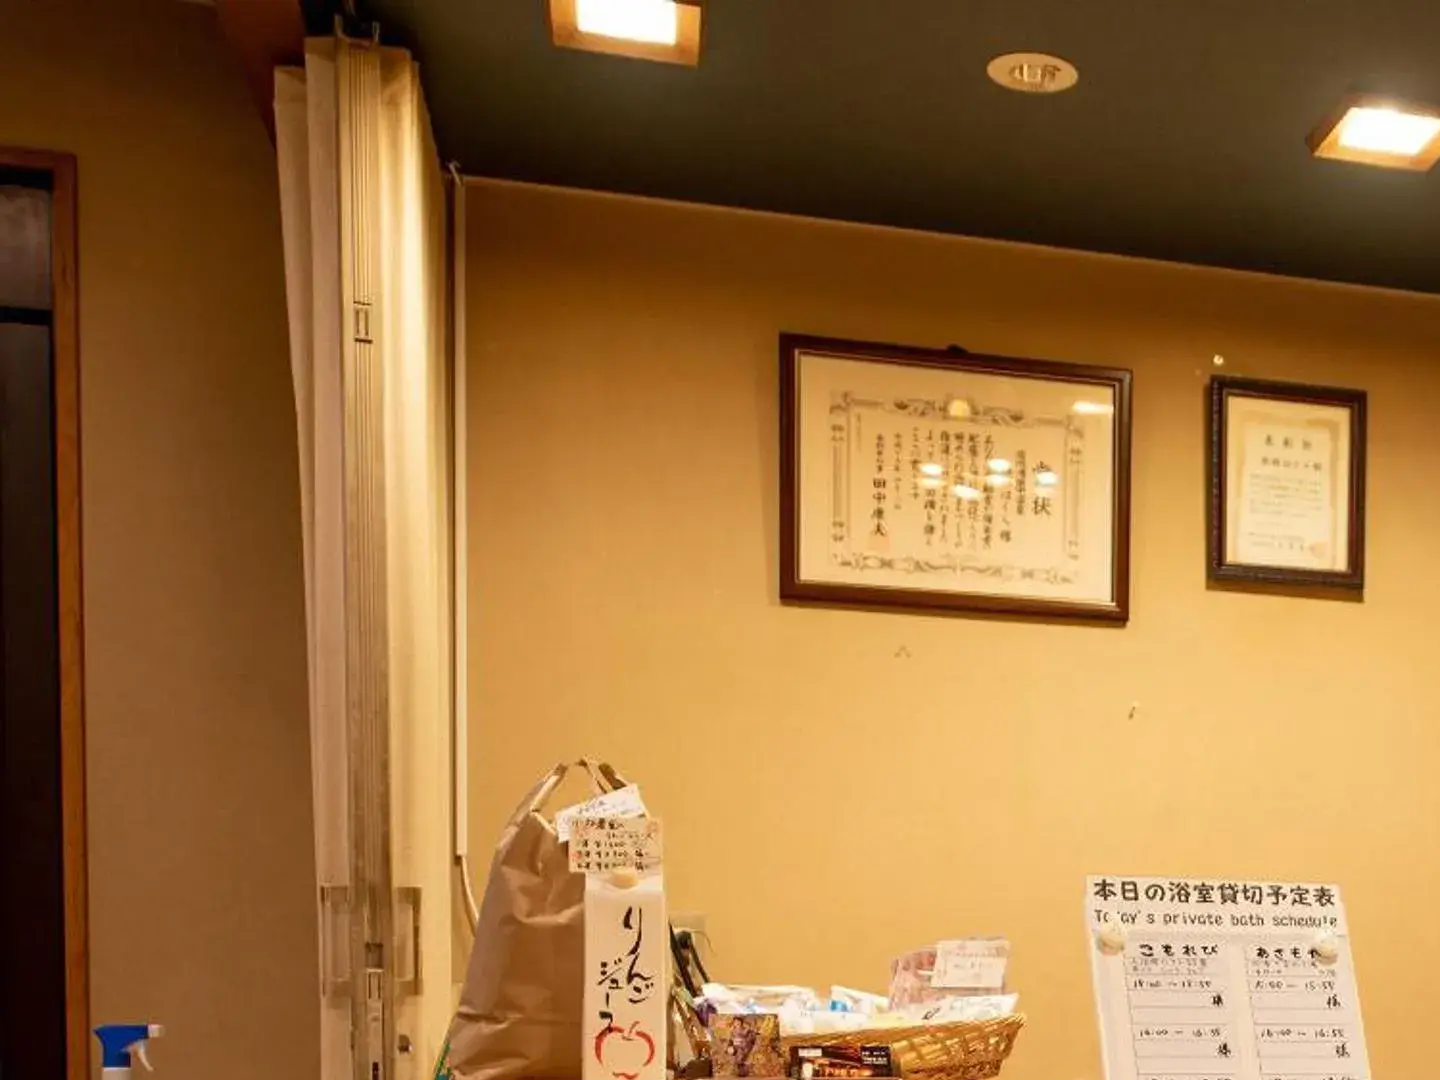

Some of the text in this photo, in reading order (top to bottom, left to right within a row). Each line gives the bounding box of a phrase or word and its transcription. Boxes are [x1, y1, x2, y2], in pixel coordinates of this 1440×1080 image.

[1093, 878, 1336, 907] 本日の浴室貸切予定表
[1163, 911, 1224, 927] private
[1230, 913, 1265, 927] bath
[623, 906, 654, 1004] りんご
[1138, 943, 1219, 958] こもれび
